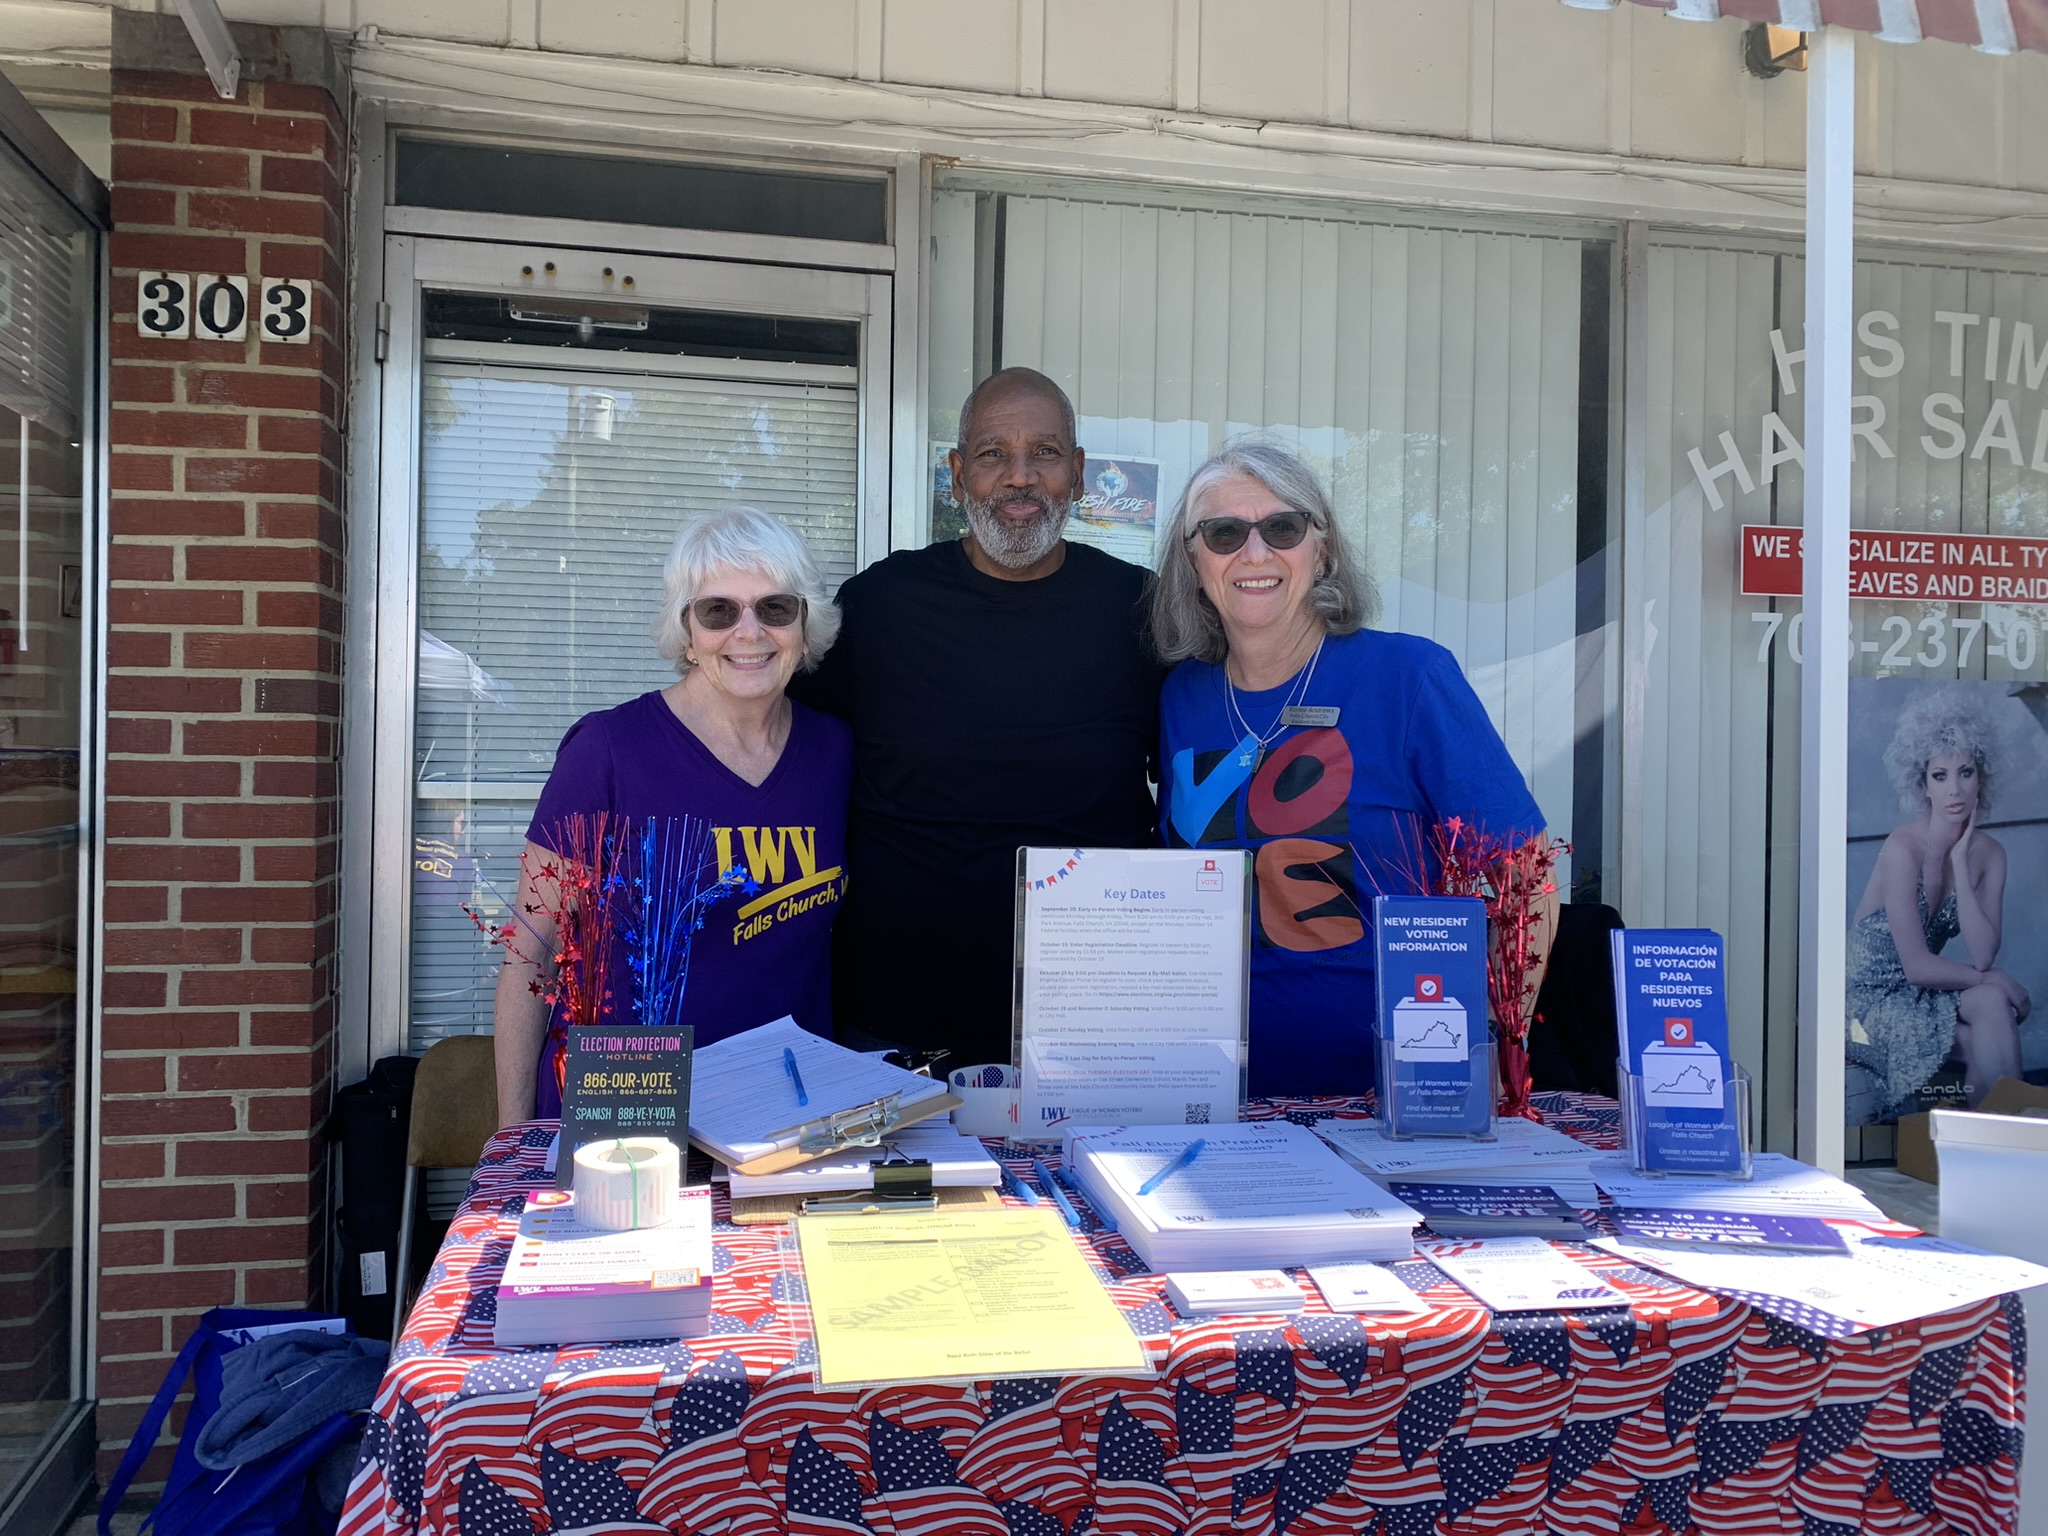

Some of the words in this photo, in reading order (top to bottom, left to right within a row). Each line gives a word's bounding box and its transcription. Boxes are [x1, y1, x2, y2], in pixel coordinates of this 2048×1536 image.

[141, 277, 306, 337] 303
[1769, 310, 1905, 396] HS
[1687, 395, 1895, 512] HAR
[1111, 497, 1148, 511] FIRE
[1752, 535, 1790, 558] WE
[1942, 543, 1963, 565] IN
[1969, 545, 2013, 567] ALL
[1849, 571, 1918, 596] EAVES
[1925, 574, 1973, 598] AND
[1104, 888, 1127, 901] Key
[1131, 888, 1166, 900] Dates
[733, 914, 773, 945] Falls
[777, 882, 838, 922] Church,
[1384, 917, 1410, 926] NEW
[1413, 917, 1468, 926] RESIDENT
[1406, 929, 1448, 939] VOTING
[1389, 942, 1468, 951] INFORMATION
[1633, 944, 1717, 955] INFORMACIÓN
[1635, 958, 1651, 967] DE
[1654, 957, 1716, 969] VOTACIÓN
[1660, 972, 1693, 981] PARA
[1641, 984, 1713, 995] RESIDENTES
[1653, 998, 1702, 1008] NUEVOS
[580, 1036, 623, 1051] ELECTION
[625, 1036, 681, 1051] PROTECTION
[583, 1072, 672, 1088] 866-OUR-VOTE
[1393, 1080, 1416, 1088] League
[575, 1107, 612, 1120] SPANISH
[618, 1107, 676, 1120] 888-VE-Y-VOTA
[1041, 1107, 1066, 1120] LWV
[1648, 1121, 1674, 1129] League
[1659, 1146, 1681, 1155] Únese
[1456, 1207, 1549, 1216] VOTE
[1640, 1229, 1769, 1243] VOTAR
[829, 1275, 962, 1332] SAMPLE
